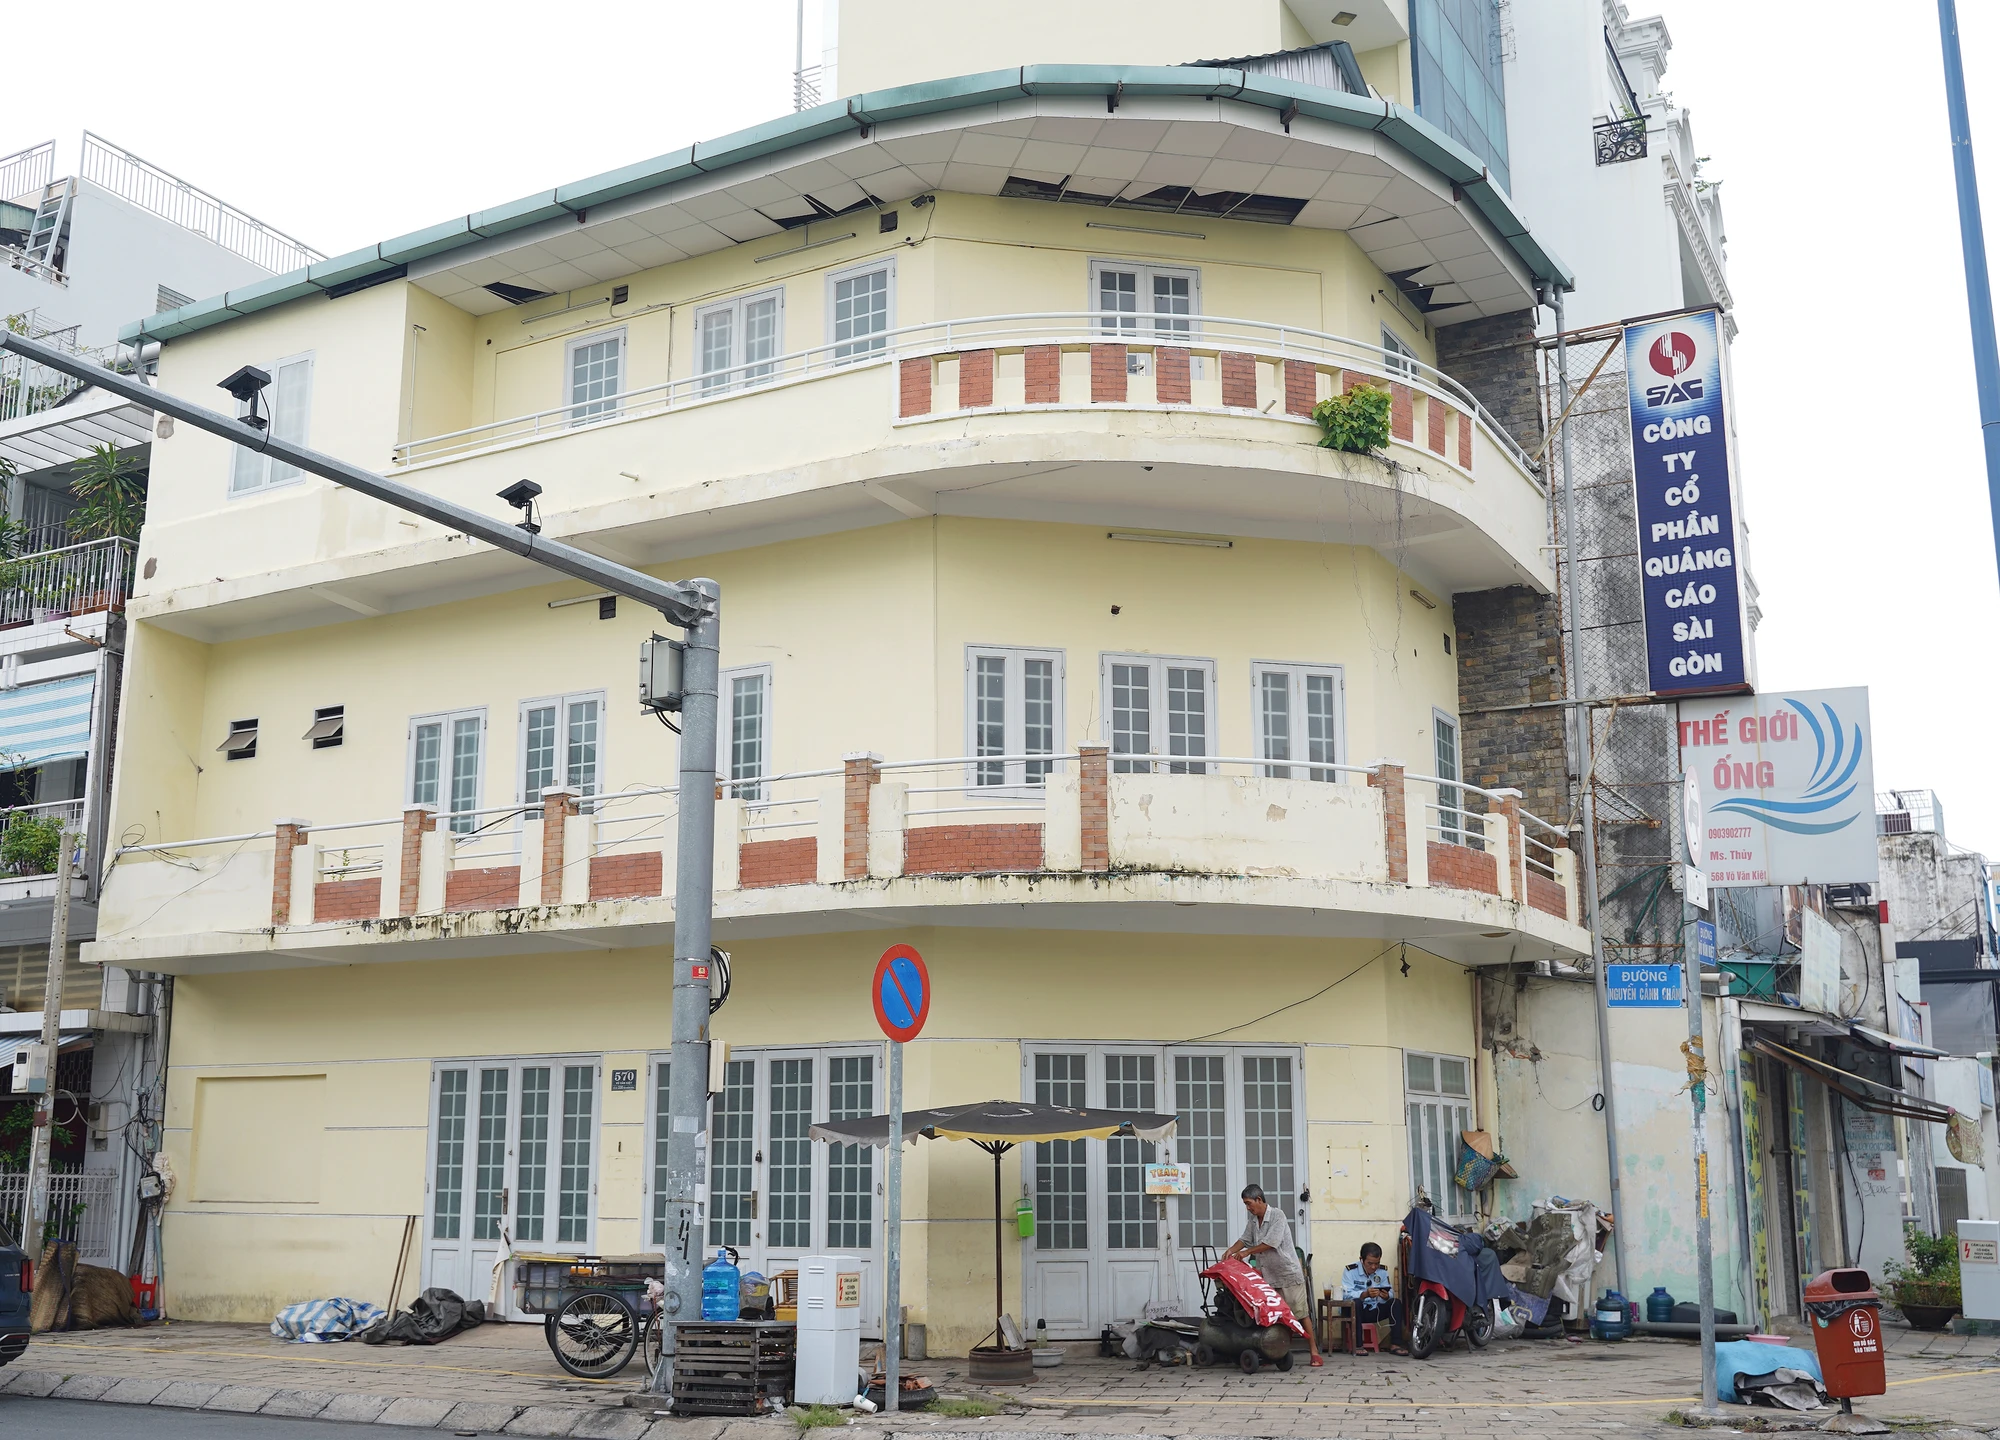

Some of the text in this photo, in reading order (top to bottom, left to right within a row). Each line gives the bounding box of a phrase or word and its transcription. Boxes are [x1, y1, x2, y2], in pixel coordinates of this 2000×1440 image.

[1643, 415, 1711, 443] CÔNG
[1662, 450, 1696, 474] TY
[1664, 474, 1700, 507] CỔ
[1651, 510, 1719, 543] PHẦN
[1644, 546, 1732, 578] QUẢNG
[1664, 583, 1717, 609] CÁO
[1672, 617, 1713, 643] SÀI
[1669, 649, 1722, 678] GÒN
[1680, 709, 1798, 747] THẾ GIỚI
[1713, 754, 1775, 790] ỐNG
[1710, 851, 1727, 861] Ms.
[1711, 871, 1724, 881] 568
[1621, 968, 1668, 982] ĐƯỜNG
[1609, 982, 1681, 1000] NGUYỄN CẢNH CHÂN
[614, 1071, 635, 1081] 570
